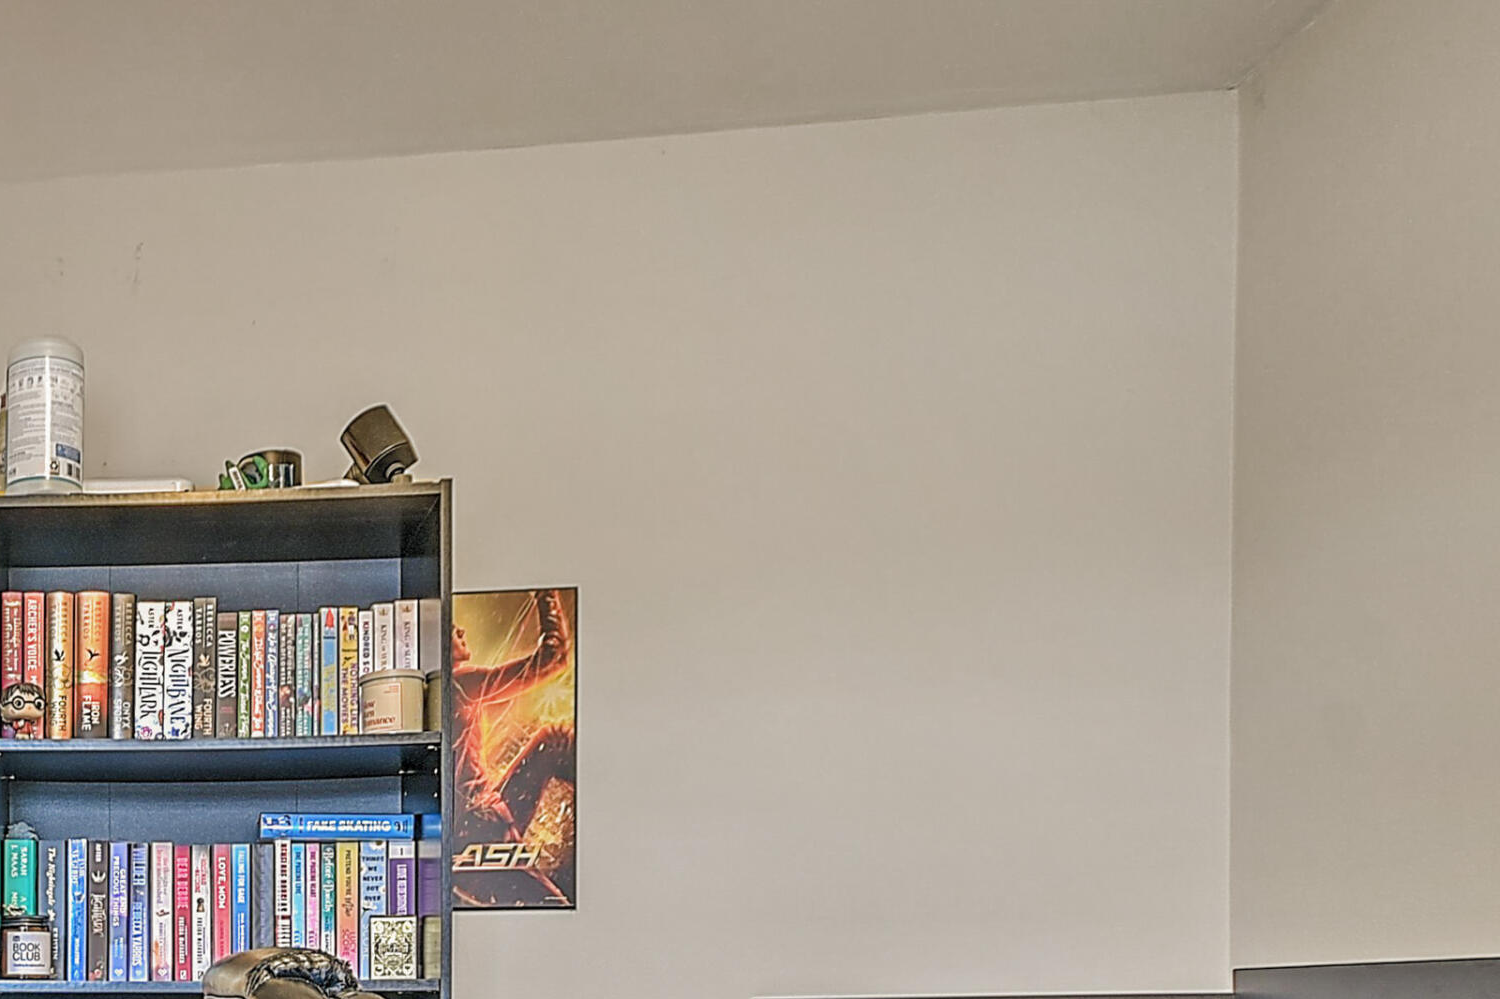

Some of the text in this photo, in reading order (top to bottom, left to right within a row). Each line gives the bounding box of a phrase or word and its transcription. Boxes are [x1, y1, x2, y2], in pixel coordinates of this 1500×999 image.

[28, 599, 37, 642] ARCHER'S
[28, 644, 37, 671] VOICE
[218, 630, 236, 698] POWERLESS
[138, 650, 164, 719] LIGHTLARK
[166, 646, 189, 724] NIGHTBANE
[350, 663, 358, 708] NOTHING
[59, 695, 67, 731] FOURTH
[82, 695, 91, 731] FLAME
[92, 702, 100, 724] IRON
[122, 702, 130, 728] ONYX
[195, 704, 203, 730] WING
[203, 699, 212, 735] FOURTH
[306, 820, 391, 831] FAKE SKATING
[133, 847, 145, 885] WILDER
[455, 843, 540, 868] ASH
[46, 863, 56, 905] Nightingale
[177, 857, 188, 909] DEAR DEBBIE
[217, 857, 226, 908] LOVE, MOM
[12, 942, 40, 952] BOOK
[12, 951, 41, 961] CLUB
[348, 931, 356, 953] LUCY
